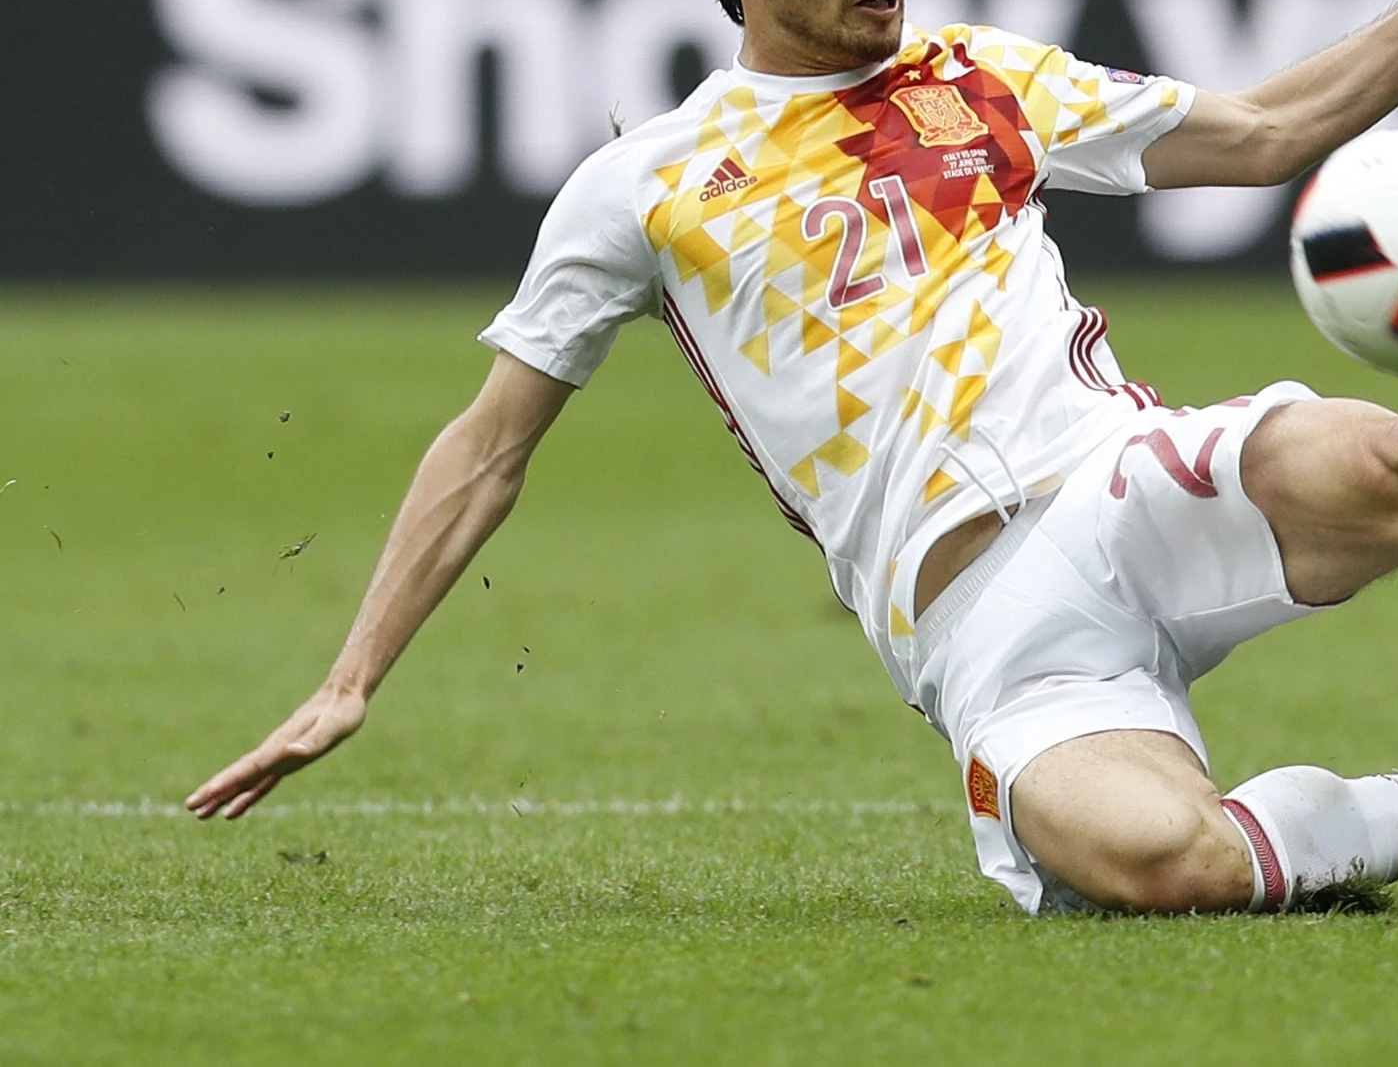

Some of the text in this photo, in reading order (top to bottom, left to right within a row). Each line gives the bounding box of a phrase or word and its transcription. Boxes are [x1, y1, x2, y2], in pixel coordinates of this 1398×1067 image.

[942, 151, 960, 163] ITALY
[699, 175, 758, 202] adidas
[801, 174, 930, 312] 21
